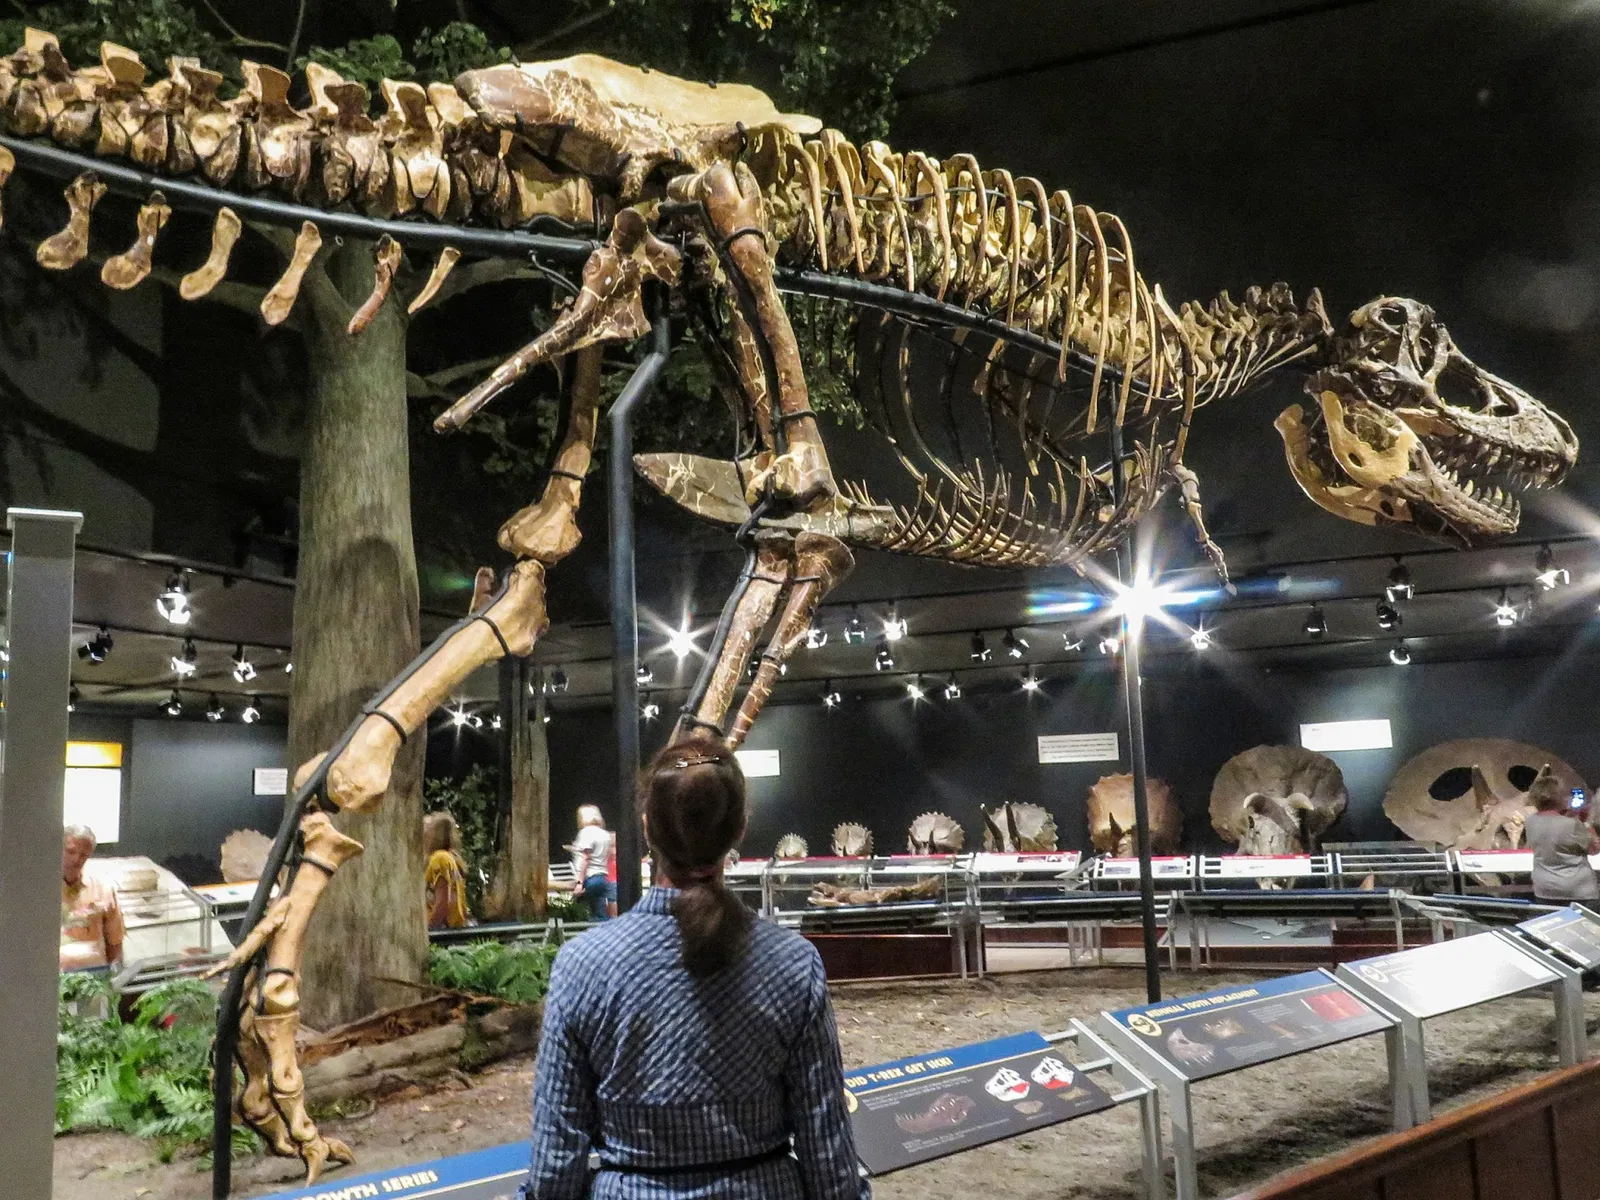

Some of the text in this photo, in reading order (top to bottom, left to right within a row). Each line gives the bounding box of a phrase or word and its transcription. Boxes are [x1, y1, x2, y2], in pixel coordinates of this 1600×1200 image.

[867, 1067, 905, 1083] T-REX
[905, 1062, 926, 1074] GET
[381, 1170, 438, 1193] SERIES
